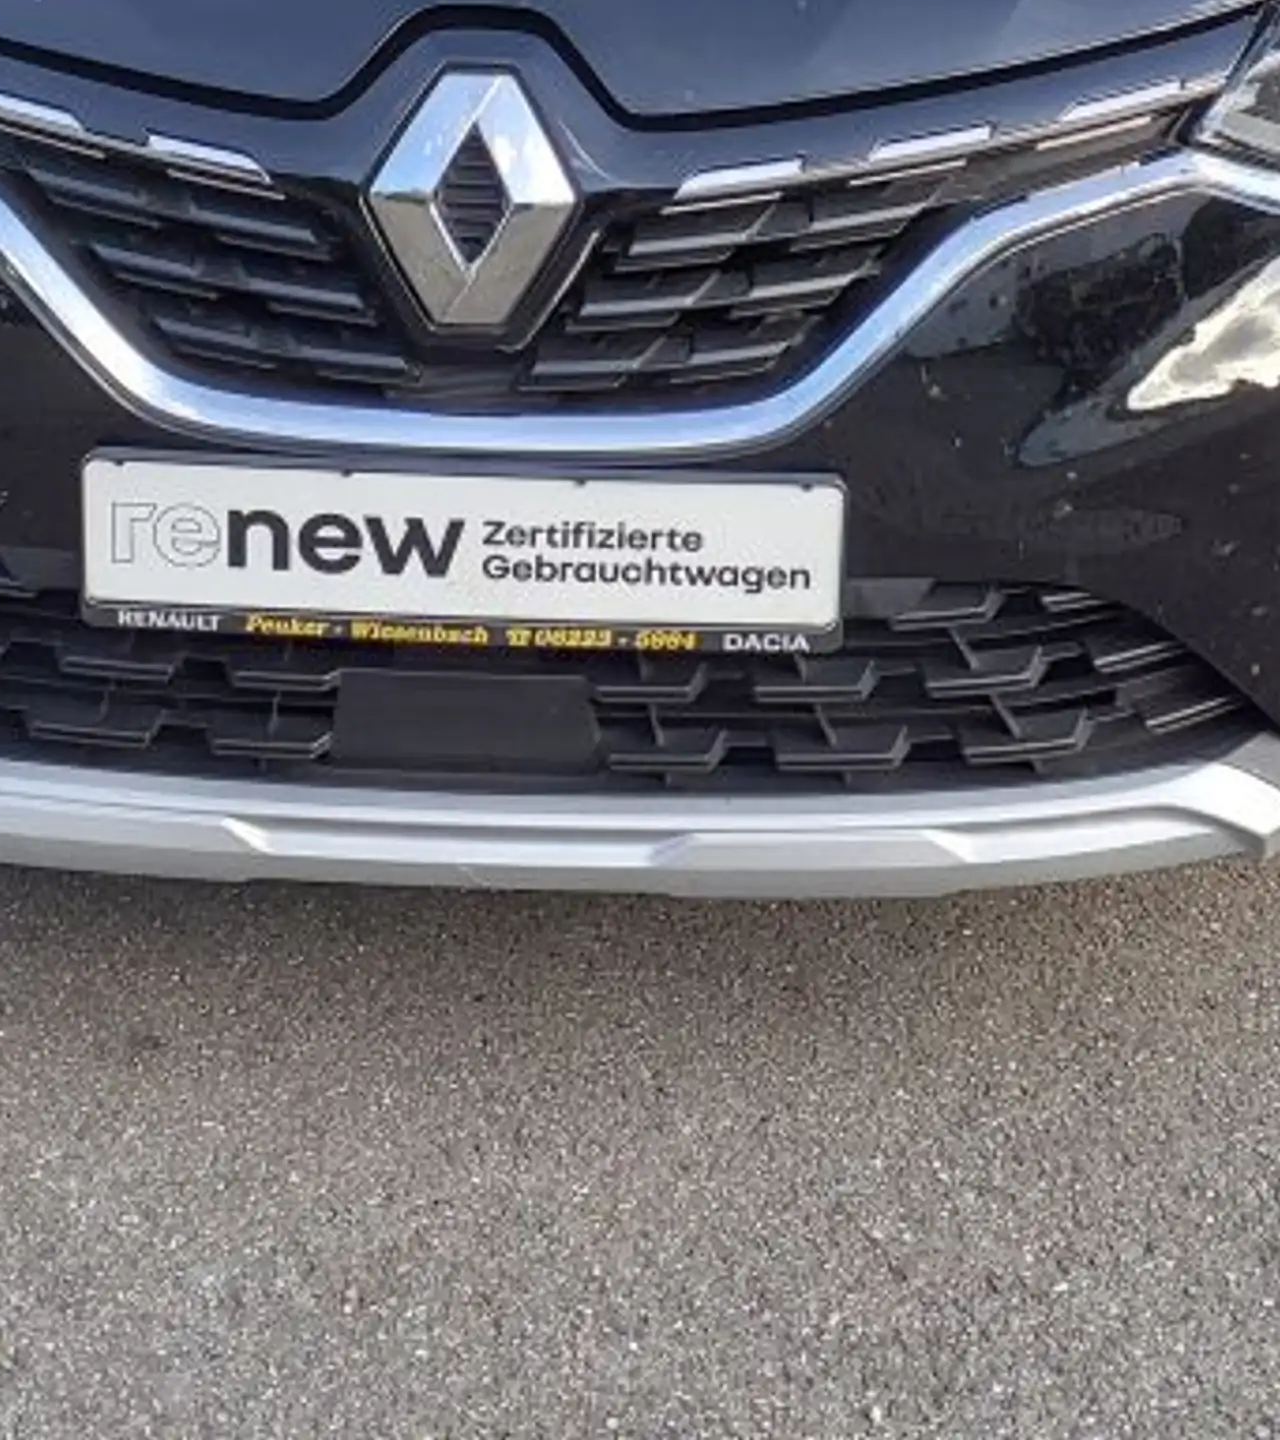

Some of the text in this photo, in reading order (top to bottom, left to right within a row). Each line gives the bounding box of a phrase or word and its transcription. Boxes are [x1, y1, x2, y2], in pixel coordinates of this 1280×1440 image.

[110, 500, 466, 578] renew
[482, 520, 705, 553] Zertifizierte
[482, 554, 812, 595] Gebrauchtwagen
[117, 610, 222, 633] RENAULT
[722, 632, 812, 653] DACIA
